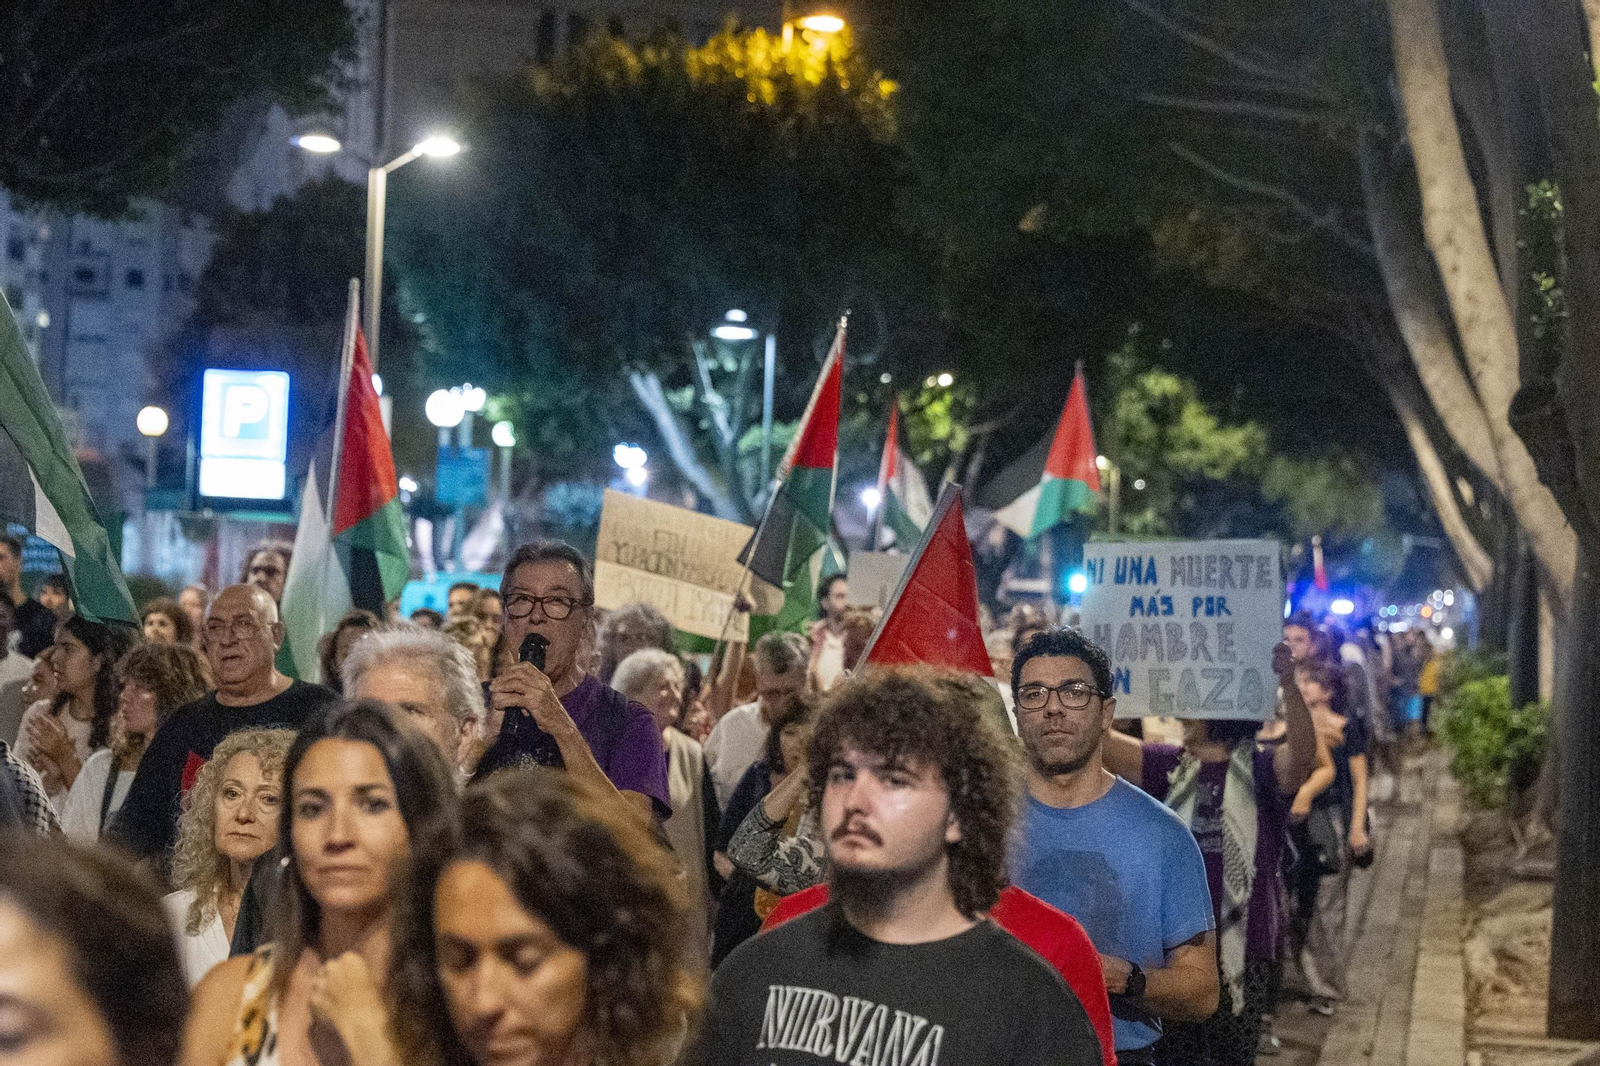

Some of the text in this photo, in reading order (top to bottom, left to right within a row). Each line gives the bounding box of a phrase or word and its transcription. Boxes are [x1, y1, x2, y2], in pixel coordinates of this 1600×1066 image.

[224, 385, 270, 438] P
[1086, 554, 1273, 589] NI UNA MUERTE
[1129, 589, 1232, 618] MÁS POR
[1112, 667, 1264, 716] N GAZA
[757, 985, 945, 1066] NIRVANA
